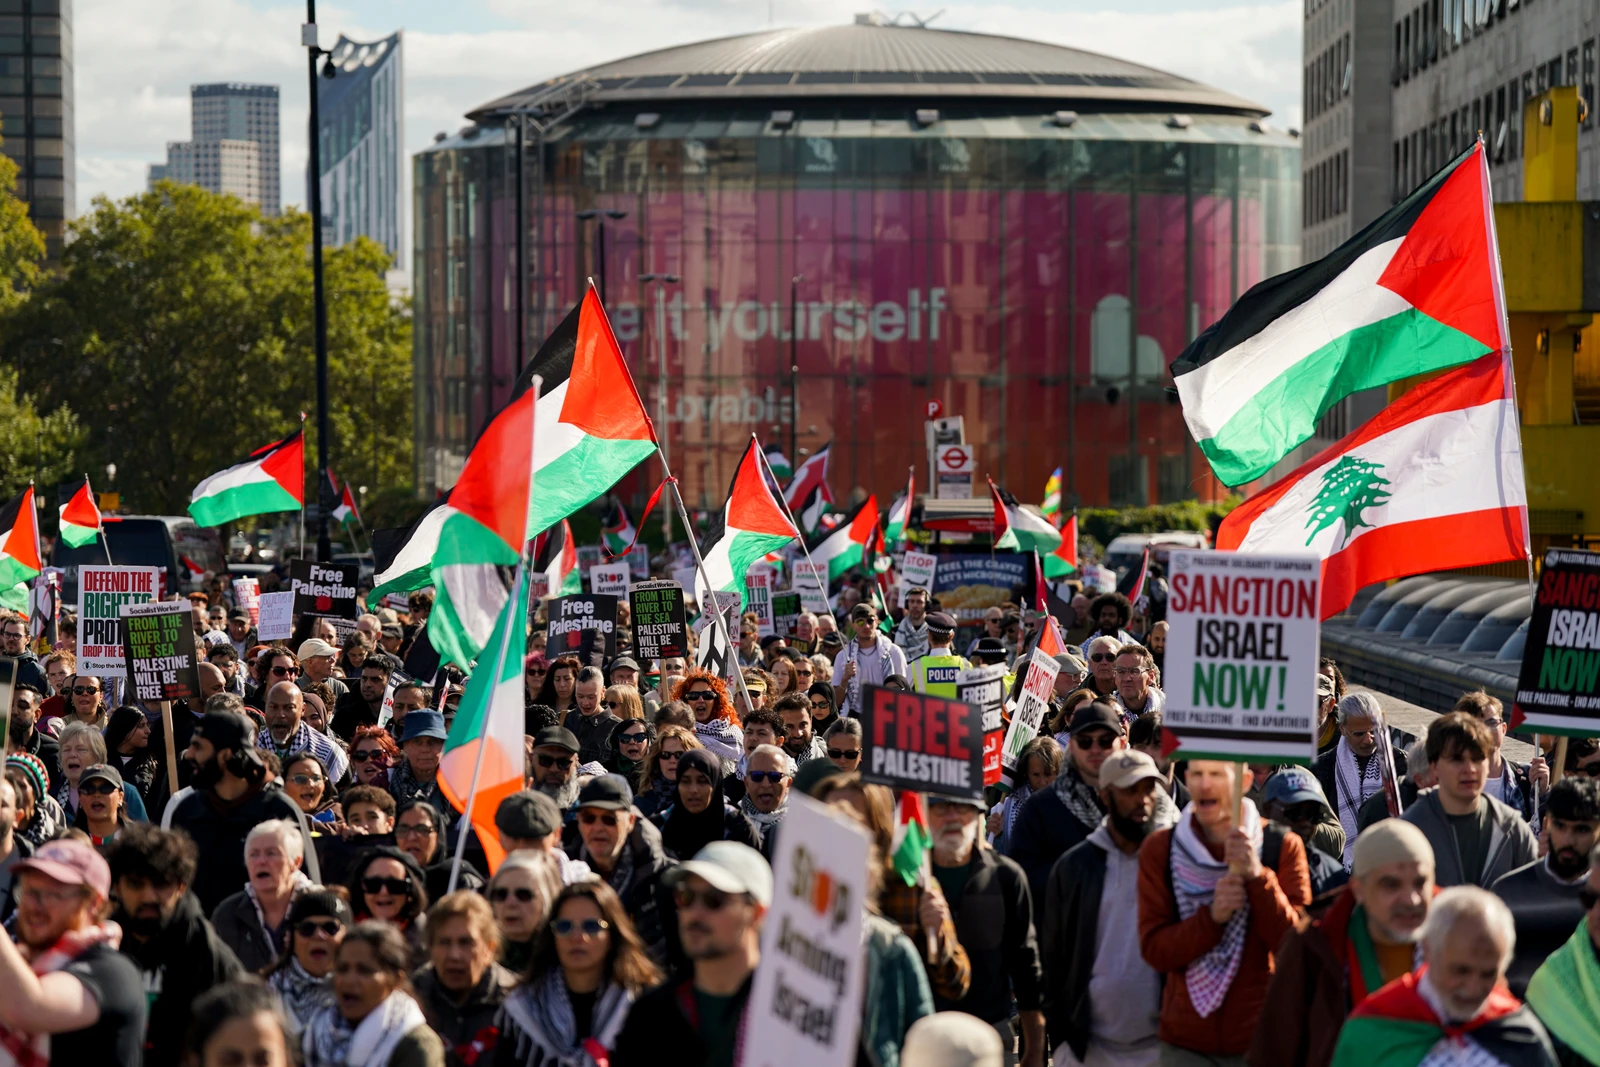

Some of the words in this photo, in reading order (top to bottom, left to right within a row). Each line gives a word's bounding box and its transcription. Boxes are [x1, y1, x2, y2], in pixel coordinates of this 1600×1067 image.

[708, 288, 946, 352] yourself
[656, 385, 799, 423] Lovable
[928, 402, 939, 417] P
[906, 555, 933, 567] STOP
[938, 562, 962, 572] FEEL
[963, 560, 983, 568] THE
[1192, 557, 1228, 568] PALESTINE
[1232, 559, 1270, 570] SOLIDARITY
[1274, 560, 1313, 572] CAMPAIGN
[1558, 552, 1586, 564] PALESTINE
[310, 565, 344, 582] Free
[796, 564, 825, 572] STOP
[84, 571, 129, 592] DEFEND
[130, 572, 152, 592] THE
[291, 578, 356, 599] Palestine
[597, 584, 626, 594] Arming
[754, 575, 766, 587] THE
[1539, 570, 1600, 608] SANC
[634, 591, 658, 602] FROM
[660, 590, 676, 600] THE
[1170, 573, 1317, 620] SANCTION
[157, 606, 180, 614] Worker
[561, 599, 594, 616] Free
[636, 602, 660, 614] RIVER
[662, 602, 673, 612] TO
[128, 616, 158, 631] FROM
[161, 614, 182, 628] THE
[550, 616, 614, 637] Palestine
[636, 614, 652, 624] THE
[654, 613, 671, 623] SEA
[82, 620, 124, 645] PROT
[130, 630, 160, 644] RIVER
[164, 628, 178, 642] TO
[637, 622, 681, 635] PALESTINE
[1546, 608, 1600, 650] ISRA
[638, 636, 658, 647] WILL
[660, 634, 672, 646] BE
[1196, 618, 1290, 662] ISRAEL
[82, 646, 102, 658] DROP
[104, 646, 116, 658] THE
[130, 645, 151, 658] THE
[154, 643, 175, 656] SEA
[640, 646, 660, 658] FREE
[132, 655, 190, 672] PALESTINE
[1538, 648, 1600, 694] NOW
[134, 672, 160, 686] WILL
[162, 670, 178, 684] BE
[928, 670, 960, 682] POLICE
[136, 685, 162, 700] FREE
[962, 680, 1002, 702] FREEDOM
[1517, 690, 1532, 703] FREE
[1534, 692, 1570, 708] PALESTINE
[1574, 696, 1586, 708] END
[873, 688, 970, 760] FREE
[982, 708, 1002, 732] STINE
[1166, 710, 1186, 722] FREE
[1188, 712, 1234, 725] PALESTINE
[1242, 714, 1258, 727] END
[1262, 716, 1309, 729] APARTHEID
[872, 746, 970, 788] PALESTINE
[775, 913, 848, 999] Arming
[770, 968, 839, 1048] Israel
